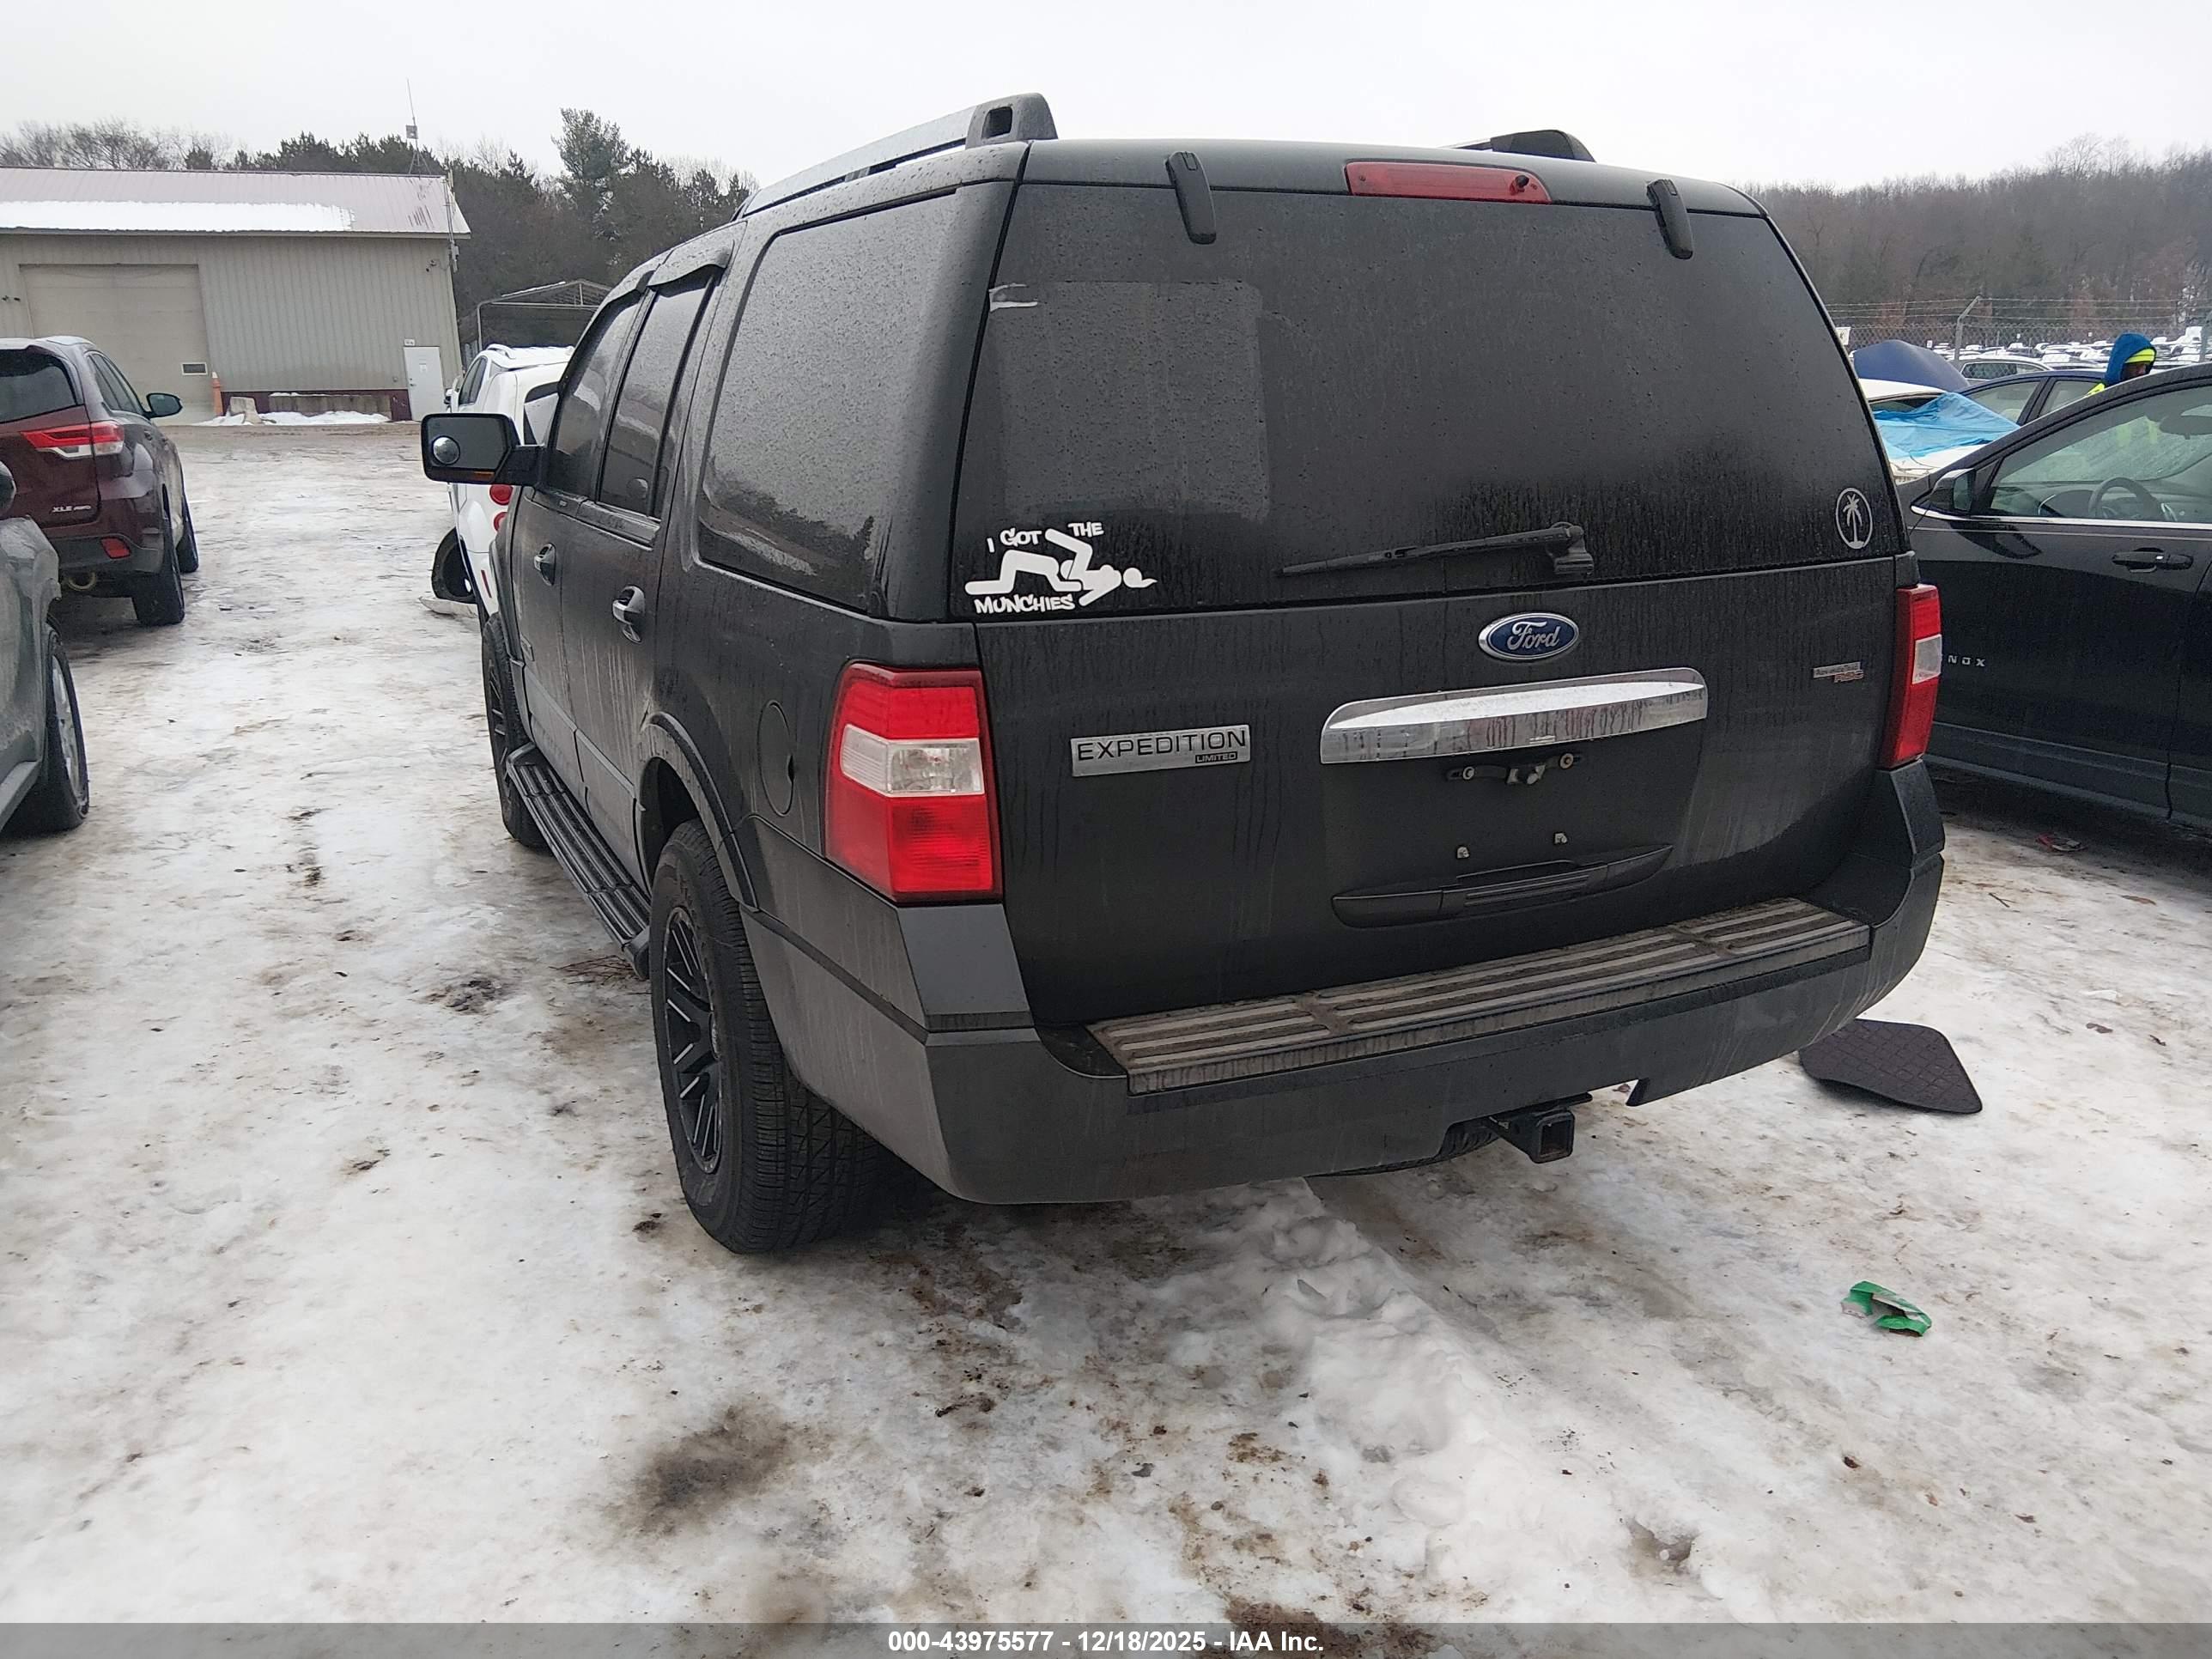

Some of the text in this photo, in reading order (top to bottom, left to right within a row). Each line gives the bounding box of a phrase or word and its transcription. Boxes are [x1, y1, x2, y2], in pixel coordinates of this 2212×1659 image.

[987, 521, 1105, 553] I GOT THE
[974, 592, 1076, 614] MUNCHIES
[1507, 621, 1561, 651] Ford
[1941, 654, 1986, 667] NOX
[1077, 730, 1246, 762] EXPEDITION
[1196, 751, 1237, 763] LIMITED
